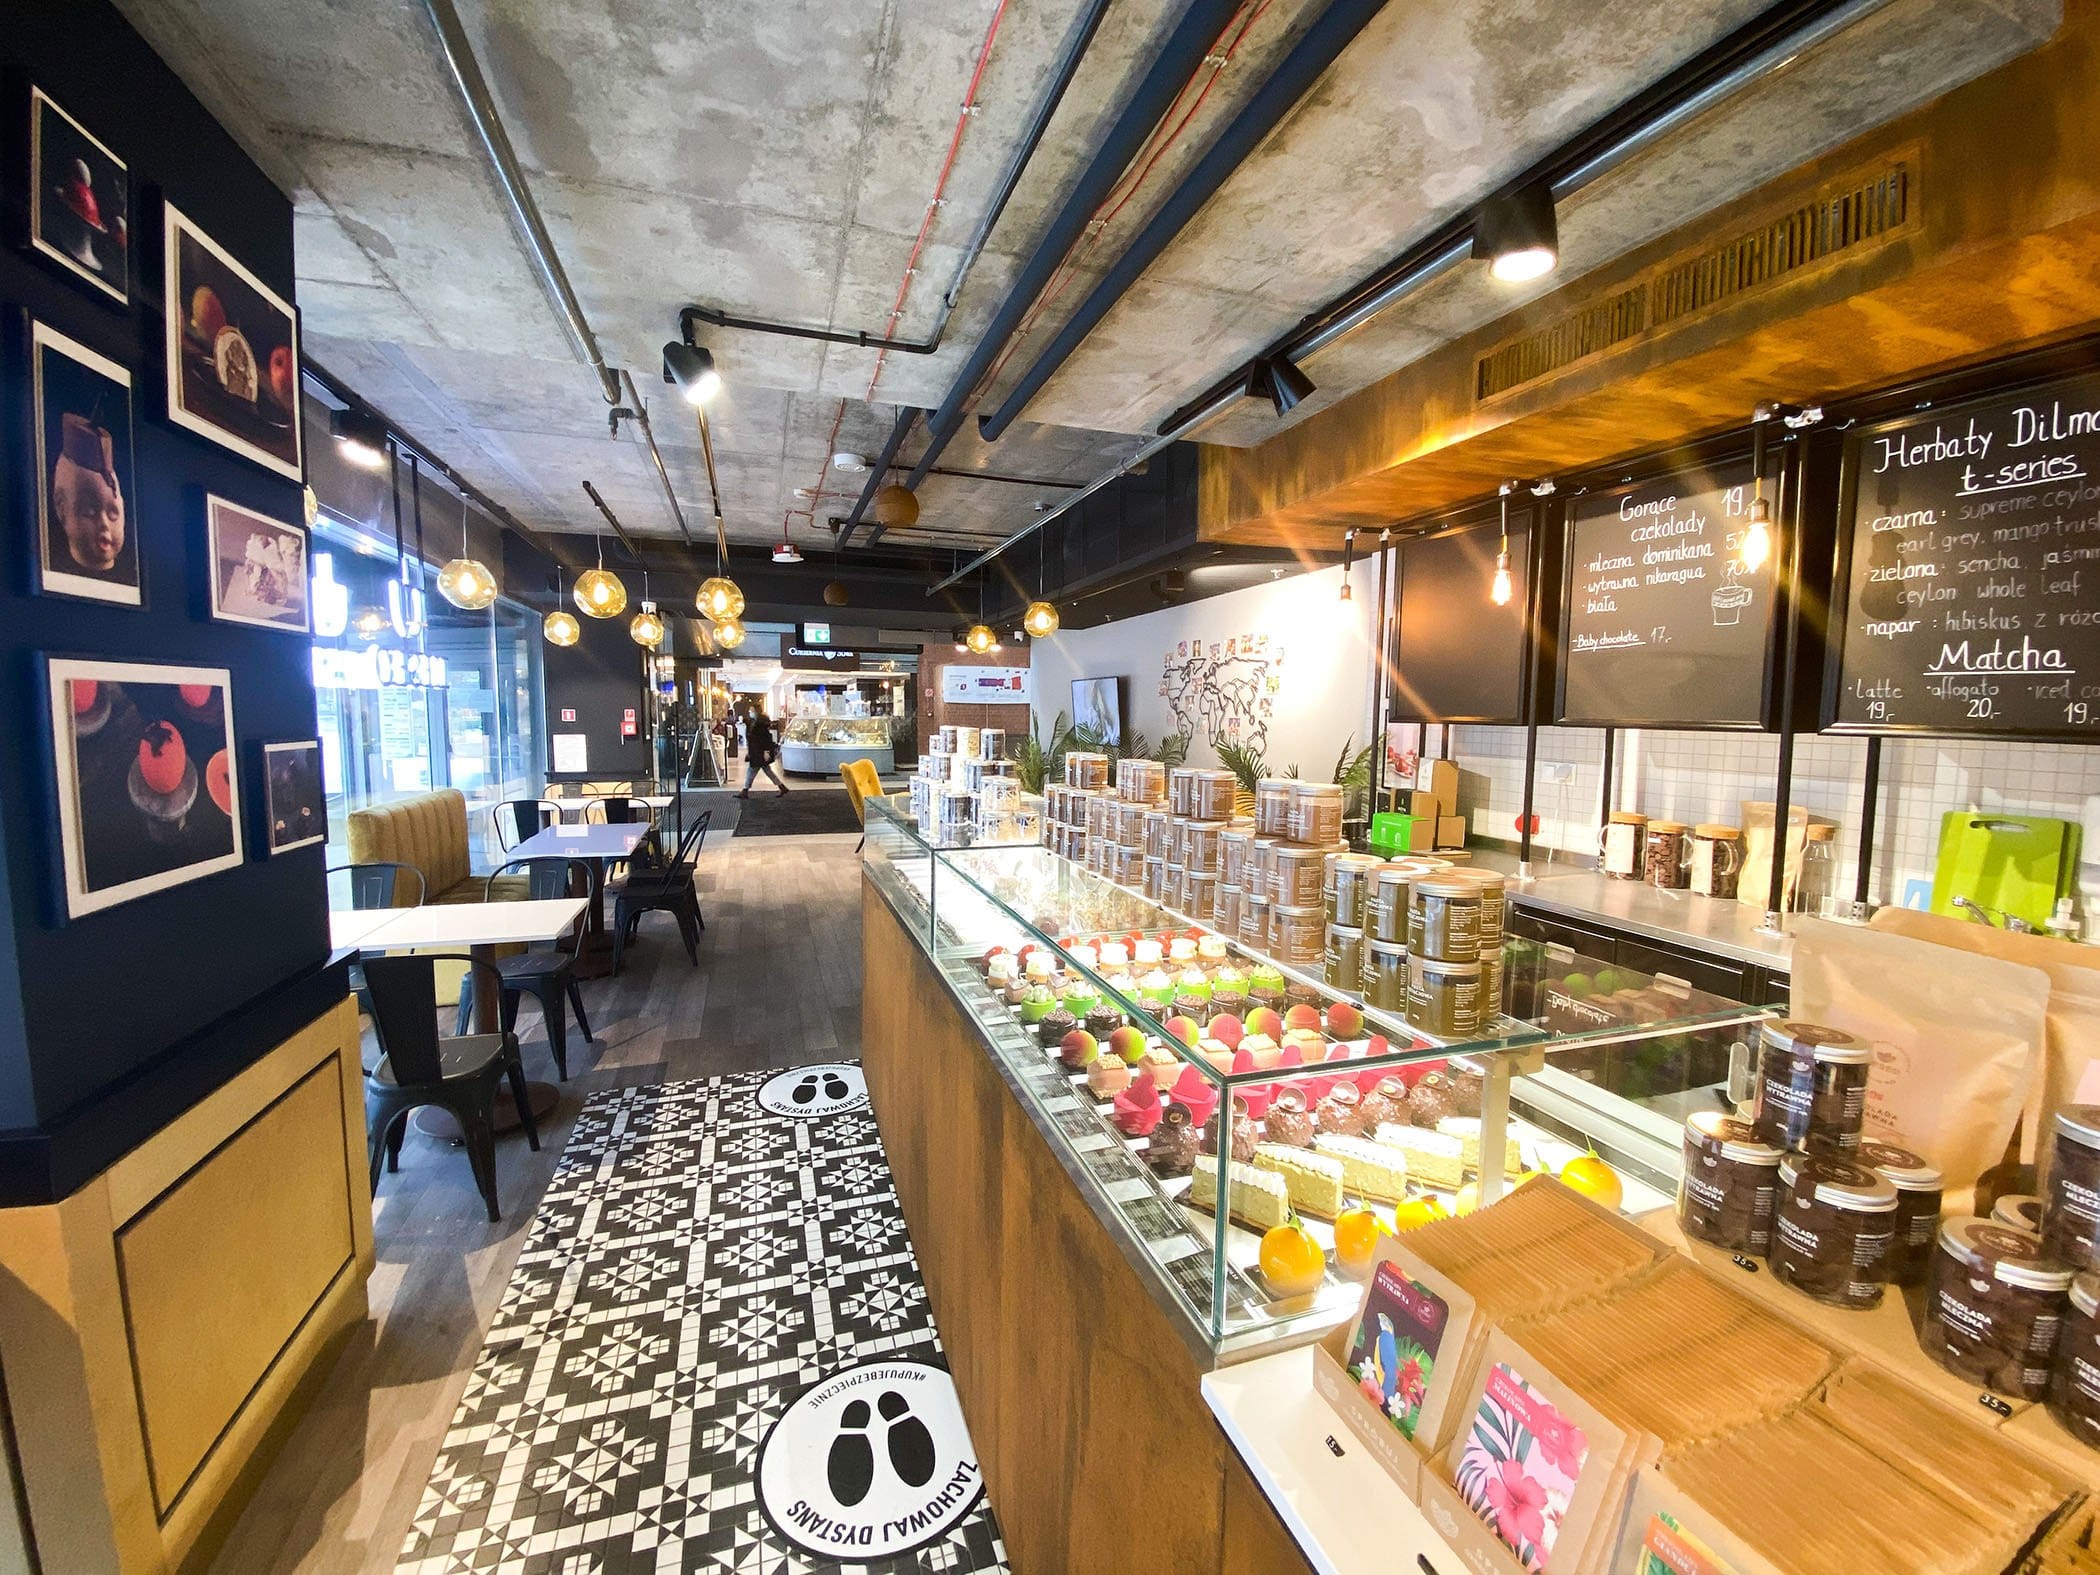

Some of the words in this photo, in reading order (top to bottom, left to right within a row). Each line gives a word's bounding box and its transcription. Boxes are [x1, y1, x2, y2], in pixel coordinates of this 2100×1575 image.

[1873, 417, 1993, 474] Herbaty
[1619, 494, 1678, 523] Gorące
[1959, 494, 2038, 521] supreme
[1630, 510, 1706, 543] czekolady
[1589, 552, 1636, 573] mleczna
[1642, 541, 1715, 566] dominikana
[1895, 531, 1937, 554] earl
[1587, 575, 1640, 596] wytrawna
[1645, 566, 1707, 585] nikaragua
[1896, 582, 1957, 609] ceylon
[1977, 576, 2026, 598] whole
[2040, 570, 2082, 597] leaf
[1586, 595, 1618, 615] biała
[1944, 607, 2021, 632] hibiskus
[1599, 629, 1640, 645] chocolate
[1927, 634, 2067, 672] Matcha
[1855, 678, 1905, 700] latte
[1931, 675, 2000, 702] affogato
[807, 1369, 928, 1410] #KUPUJEBEZPIECZNIE
[883, 1459, 979, 1543] ZACHOWAJ
[786, 1499, 874, 1546] DYSTANS
